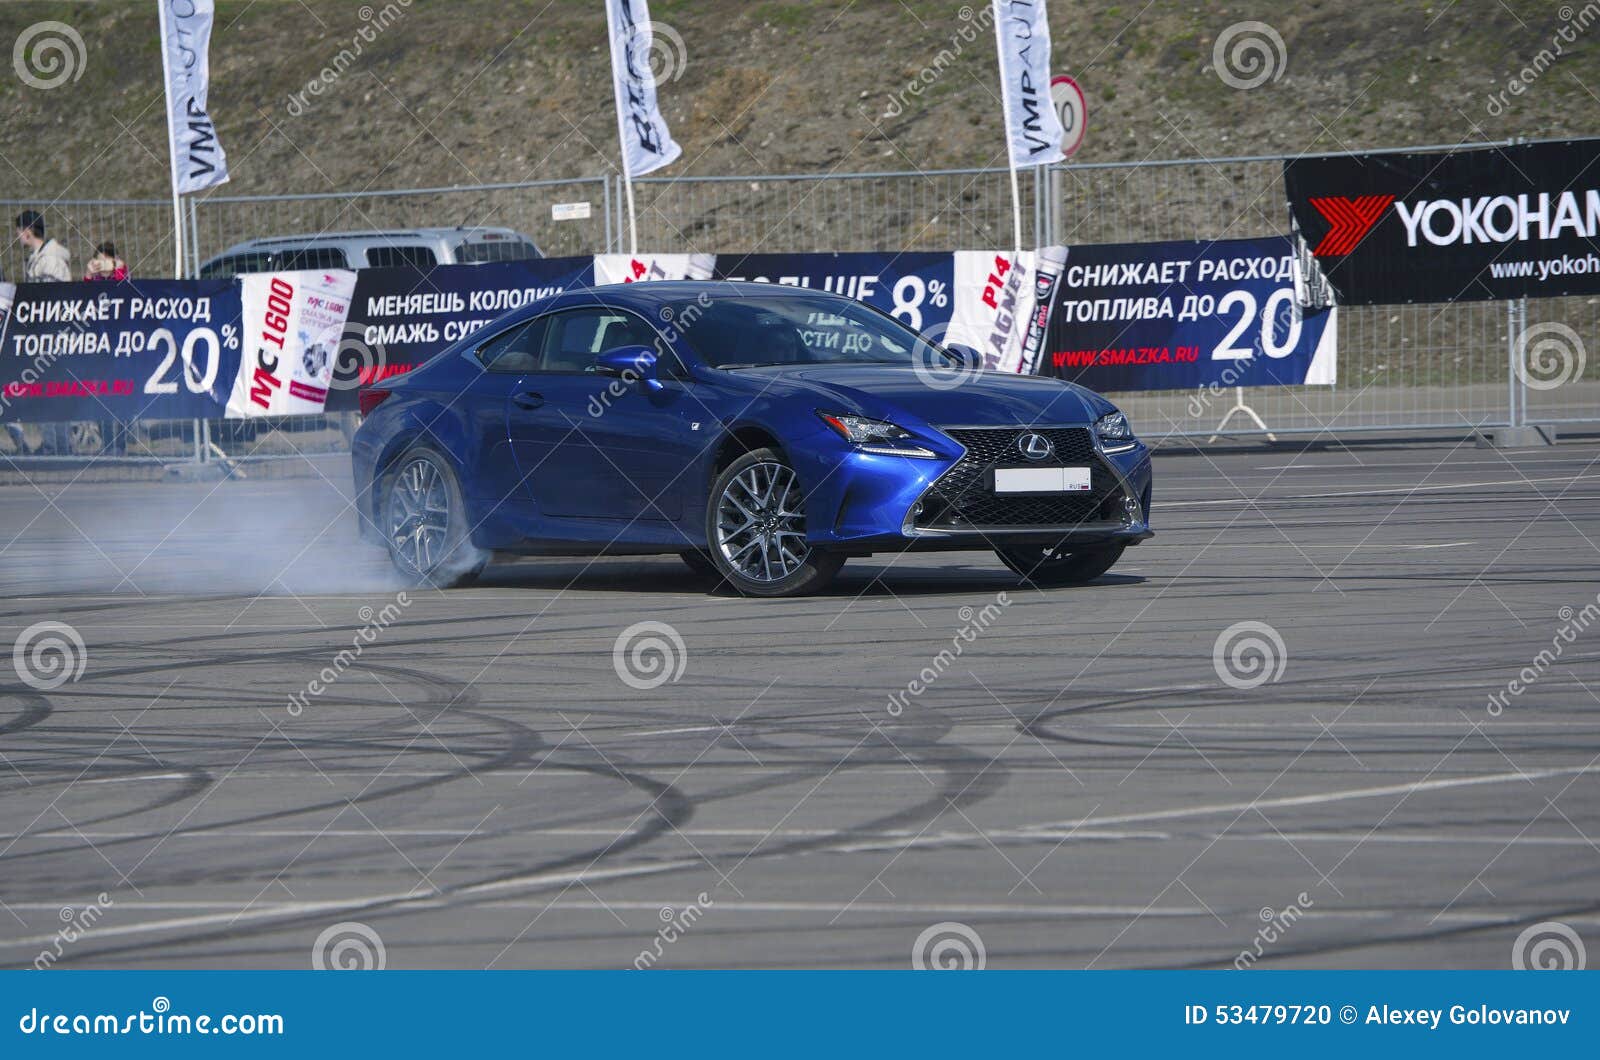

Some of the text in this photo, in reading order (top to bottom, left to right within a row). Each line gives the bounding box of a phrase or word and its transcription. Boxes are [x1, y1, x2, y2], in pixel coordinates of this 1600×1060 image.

[1067, 261, 1191, 287] СНИЖАЕТ
[1198, 255, 1294, 283] РАСХОД
[16, 297, 211, 323] СНИЖАЕТ РАСХОД
[367, 292, 465, 317] МЕНЯЕШЬ
[1064, 298, 1175, 323] ТОПЛИВА
[1178, 294, 1215, 322] ДО
[13, 332, 111, 356] ТОПЛИВА
[114, 330, 145, 358] ДО
[364, 323, 439, 345] СМАЖЬ
[797, 329, 840, 349] СТИ
[1053, 346, 1199, 367] WWW.SMAZKA.RU
